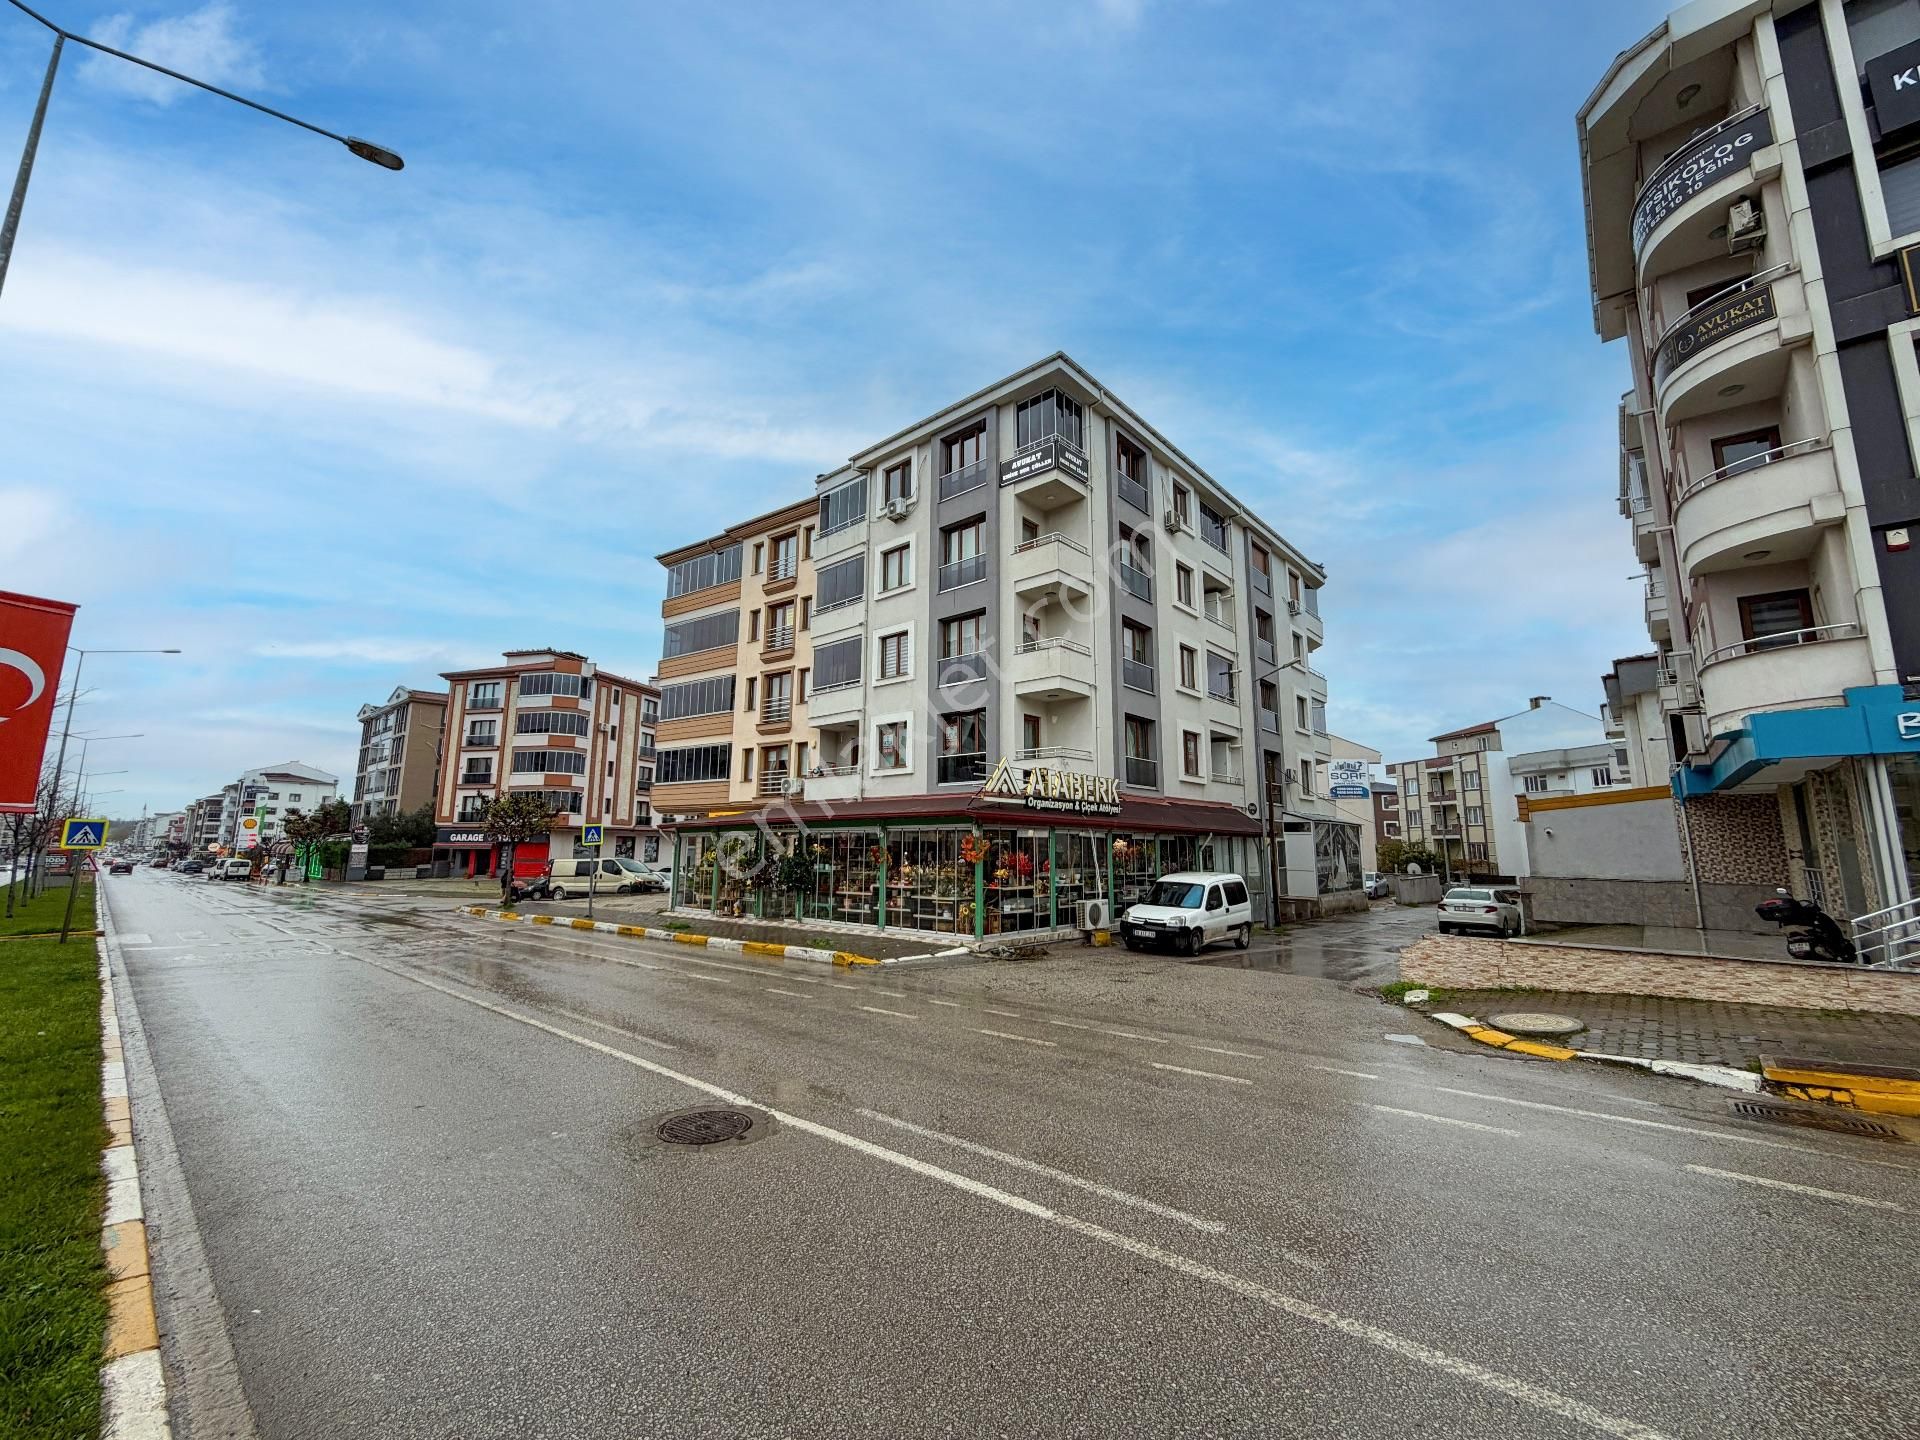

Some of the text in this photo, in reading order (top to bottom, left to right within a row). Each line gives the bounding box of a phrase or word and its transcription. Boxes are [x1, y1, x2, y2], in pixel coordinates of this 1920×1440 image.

[1669, 195, 1683, 208] 10
[1687, 181, 1703, 195] 10
[1696, 295, 1767, 336] AVUKAT
[1027, 767, 1120, 804] ATABERK
[1028, 797, 1074, 812] Organizasyon
[1074, 801, 1080, 810] &
[1081, 801, 1098, 815] Çiçek
[450, 833, 485, 842] GARAGE
